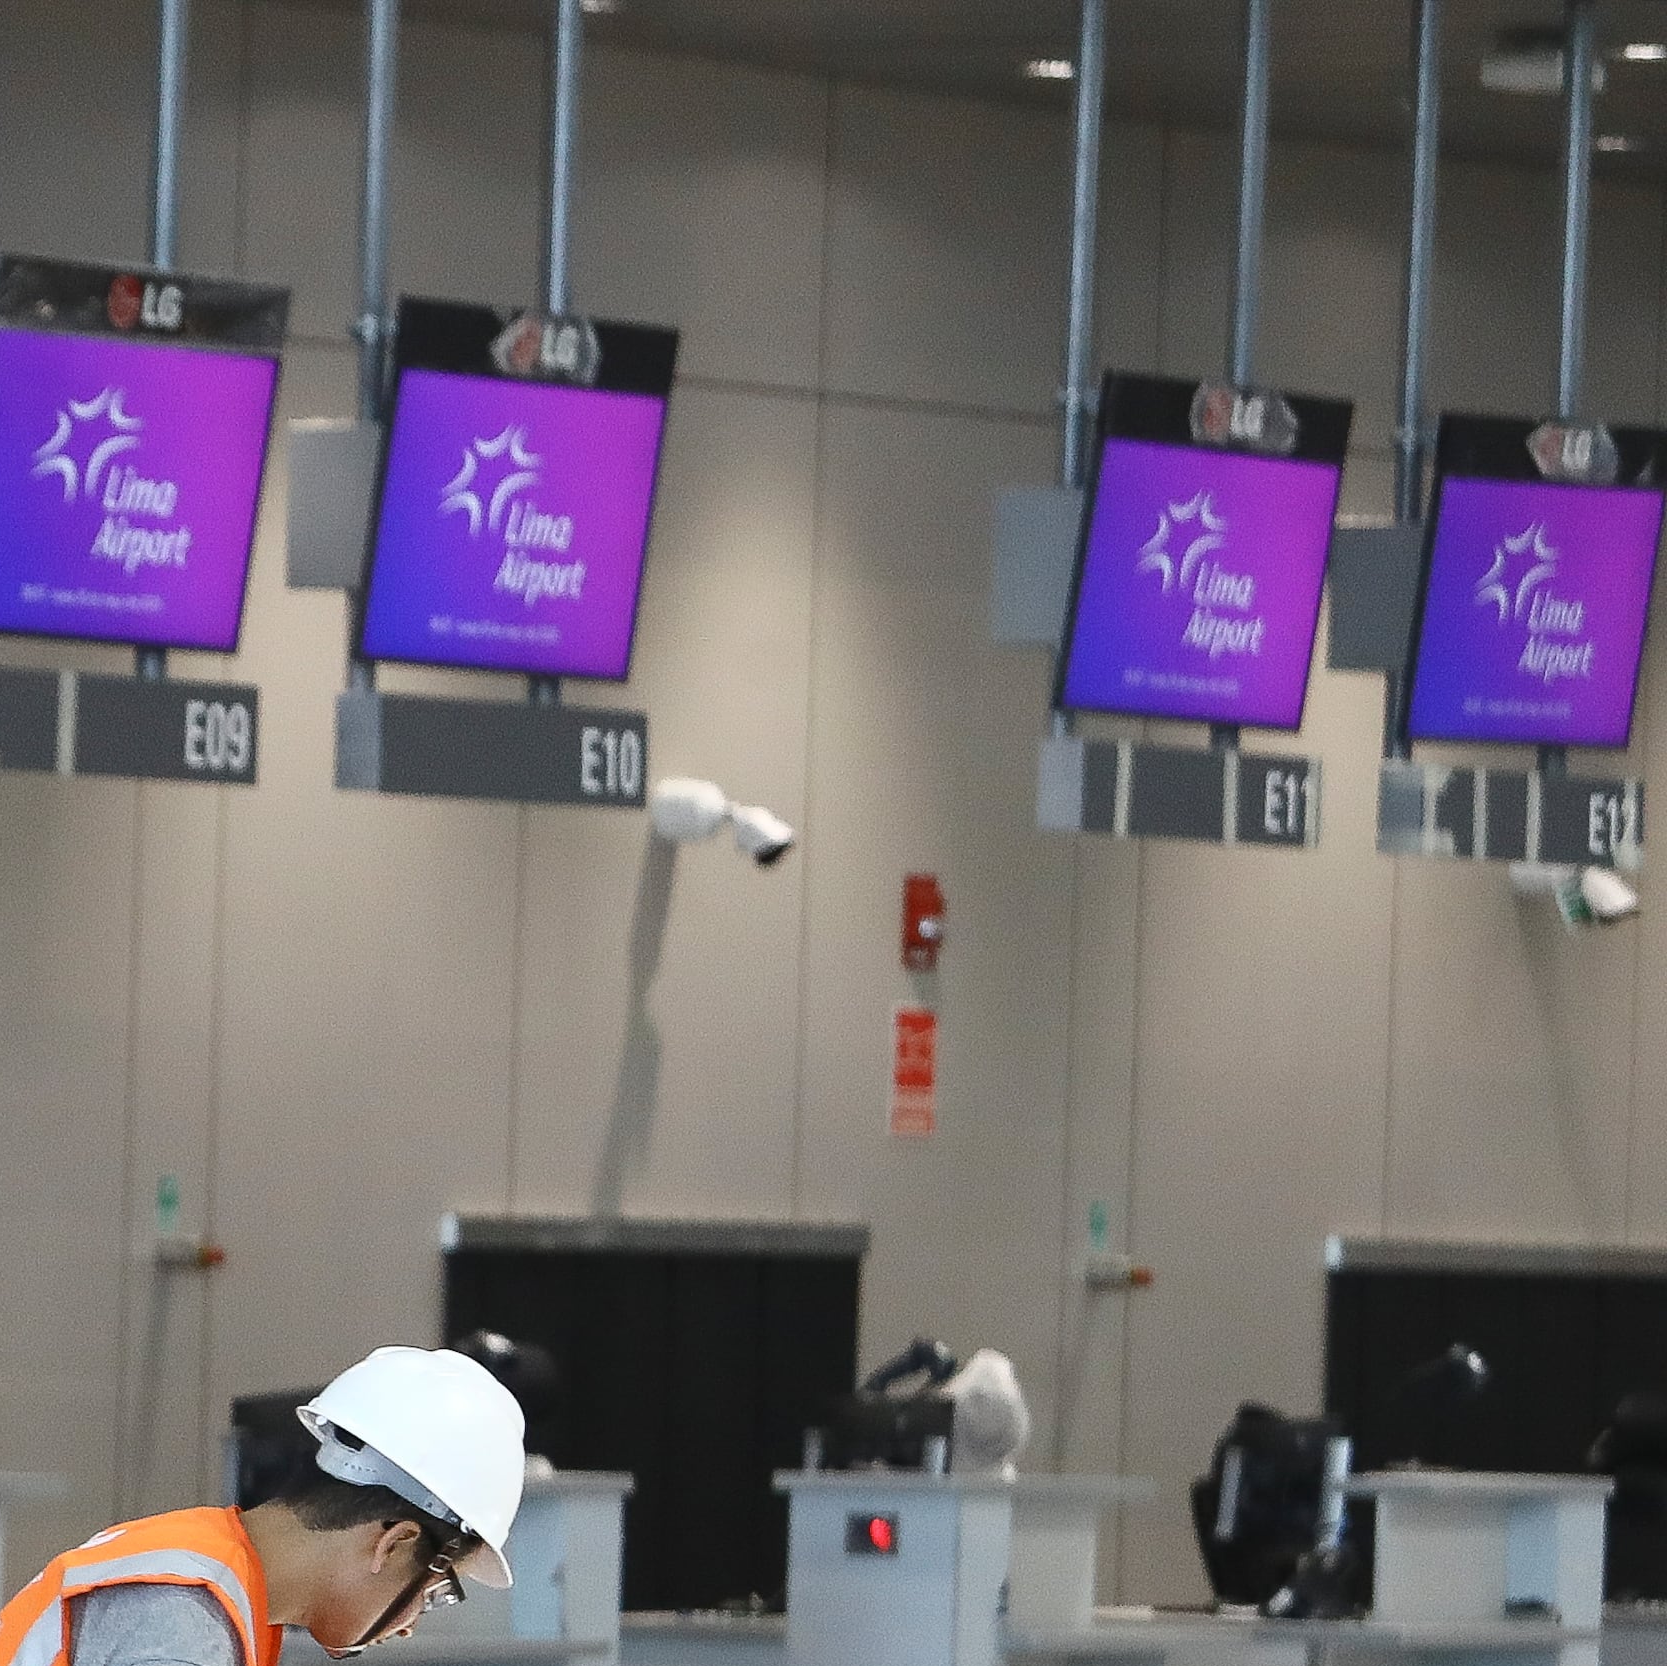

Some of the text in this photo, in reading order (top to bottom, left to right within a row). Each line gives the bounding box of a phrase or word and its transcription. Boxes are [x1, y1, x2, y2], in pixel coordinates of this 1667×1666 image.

[140, 284, 185, 330] LG
[102, 467, 178, 519] Lima
[91, 515, 191, 576] Airport
[505, 500, 574, 551] Lima
[493, 549, 587, 608] Airport
[1193, 559, 1255, 608] Lima
[1183, 608, 1267, 660] Airport
[1528, 588, 1584, 636] Lima
[1517, 634, 1594, 687] Airport
[183, 698, 252, 773] E09
[579, 725, 643, 798] E10
